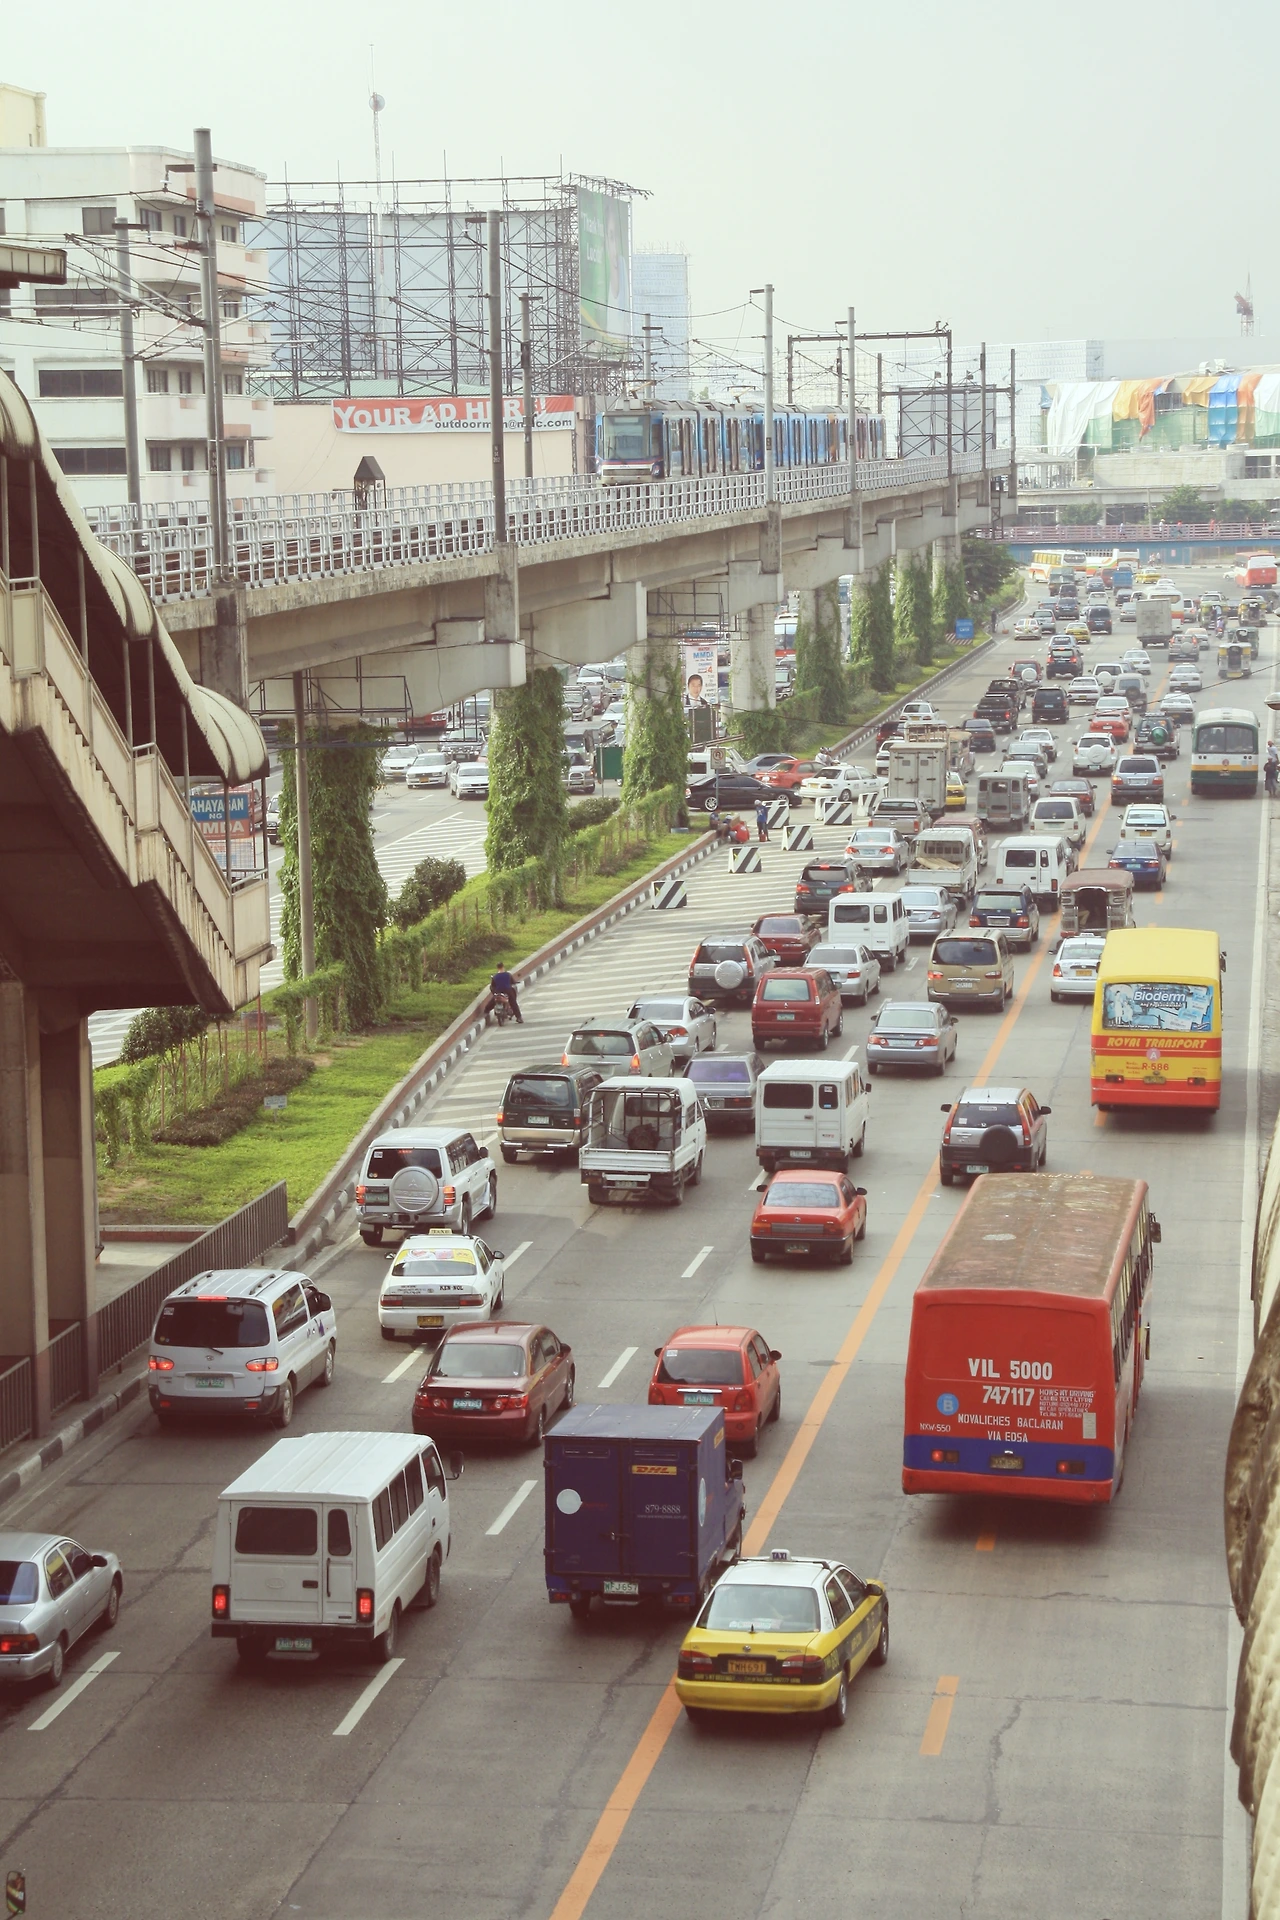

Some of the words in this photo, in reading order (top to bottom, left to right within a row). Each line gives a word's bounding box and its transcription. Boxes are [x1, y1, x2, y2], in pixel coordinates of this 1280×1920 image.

[334, 405, 414, 429] YOUR
[420, 402, 458, 424] AD
[1134, 991, 1186, 1002] Bioderm
[1107, 1038, 1140, 1047] ROYAL
[1146, 1038, 1207, 1048] TRANSPORT
[1150, 1051, 1158, 1060] A
[968, 1358, 1000, 1378] VIL
[1010, 1360, 1053, 1381] 5000
[982, 1386, 1034, 1406] 747117
[958, 1414, 1010, 1426] NOVALICHES
[1017, 1417, 1064, 1430] BACLARAN
[988, 1431, 1002, 1442] VIA
[644, 1504, 681, 1514] 879-8888
